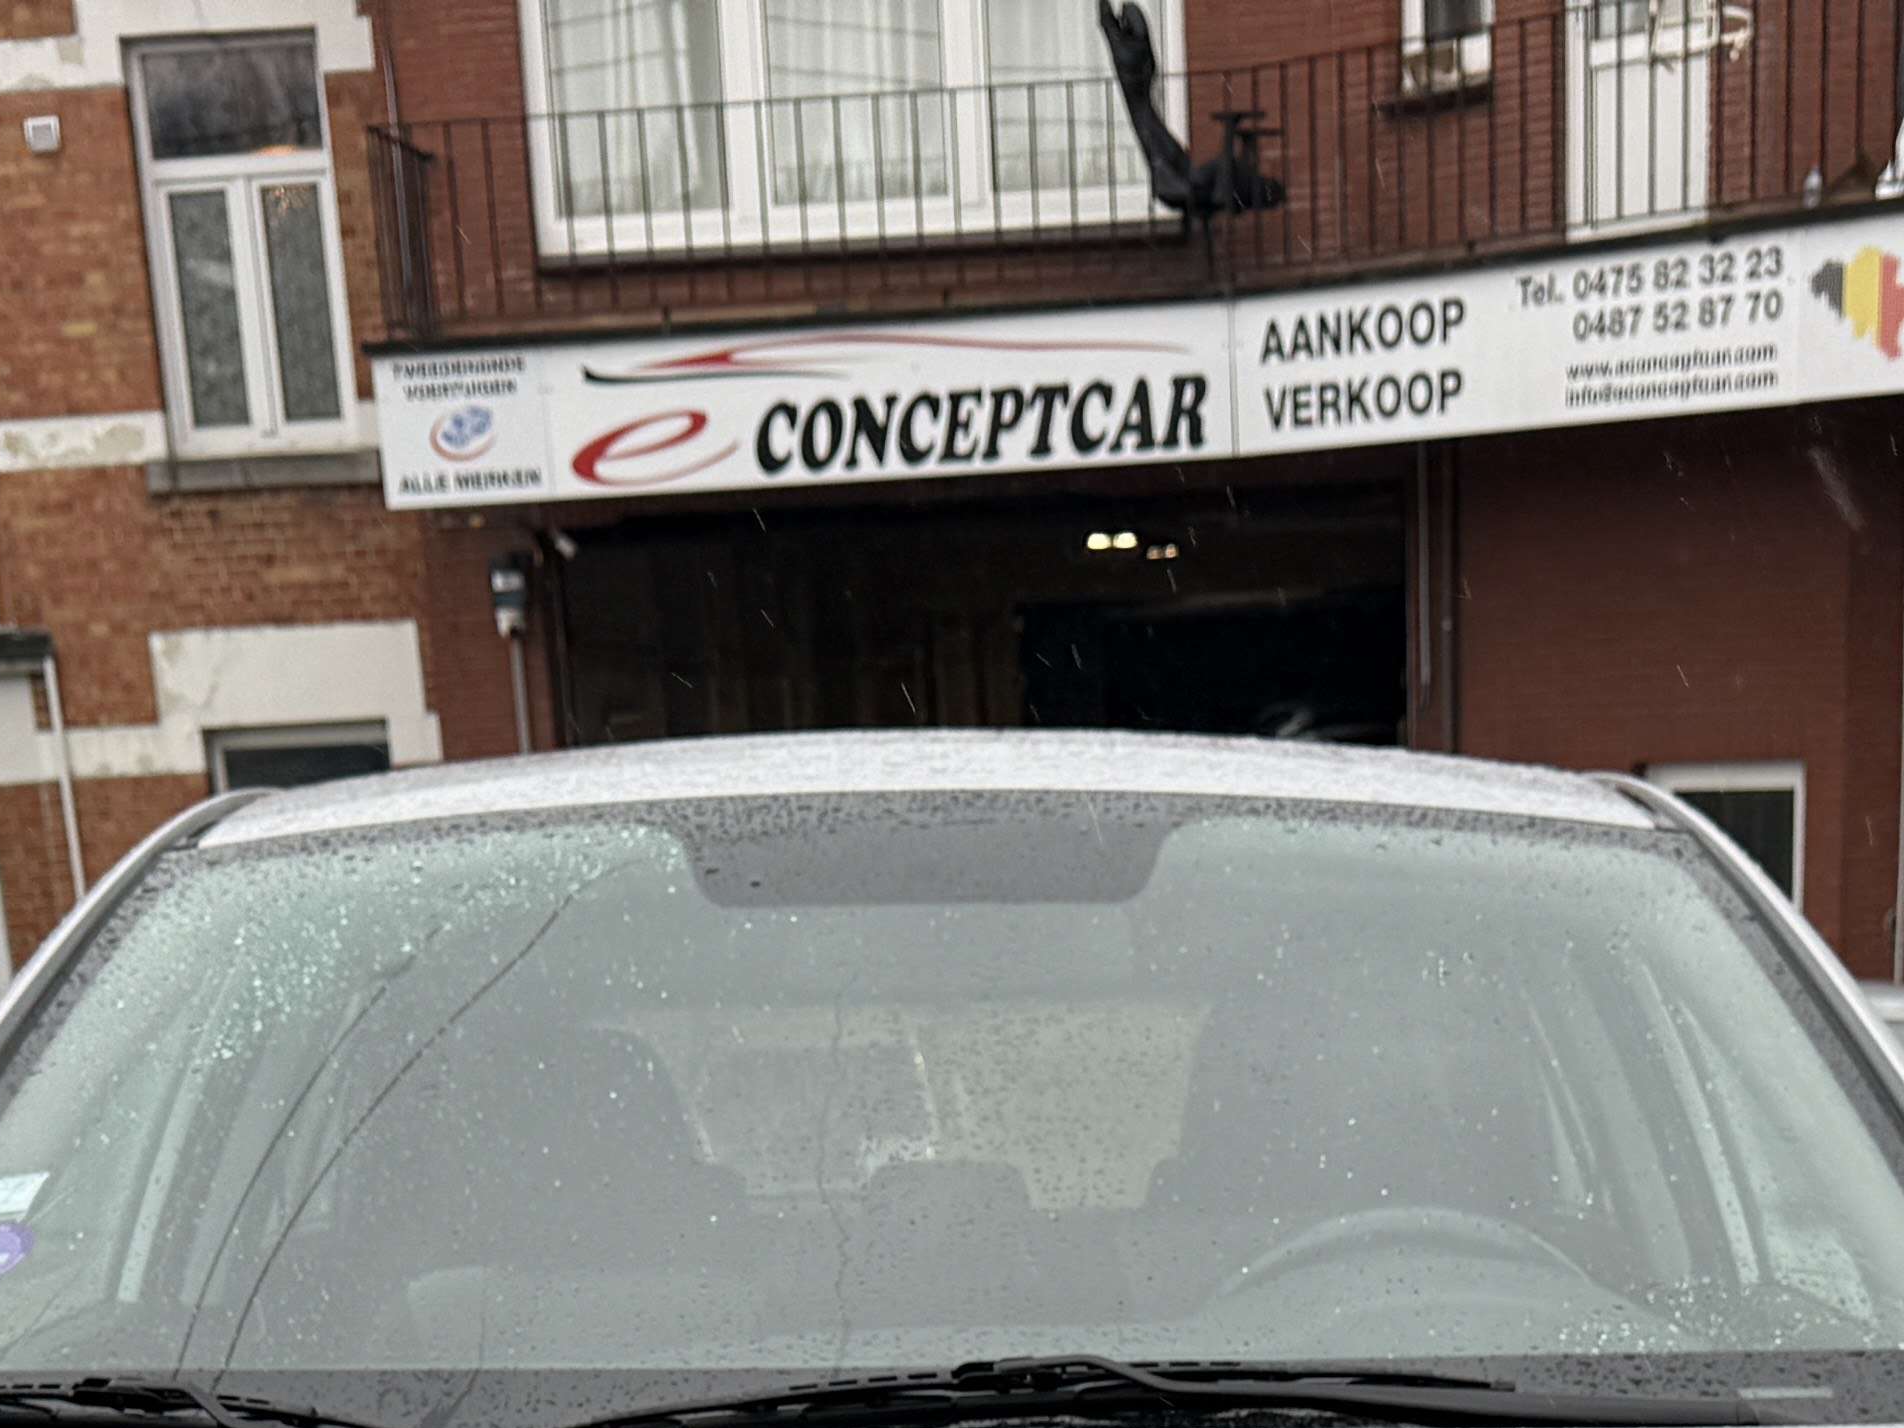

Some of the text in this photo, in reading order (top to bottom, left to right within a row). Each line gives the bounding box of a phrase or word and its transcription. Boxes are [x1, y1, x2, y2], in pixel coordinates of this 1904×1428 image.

[1517, 246, 1784, 306] Tel. 0475 82 32 23
[1260, 299, 1465, 364] AANKOOP
[1572, 289, 1784, 342] 0487 52 87 70
[755, 374, 1208, 474] CONCEPTCAR
[1264, 369, 1463, 431] VERKOOP
